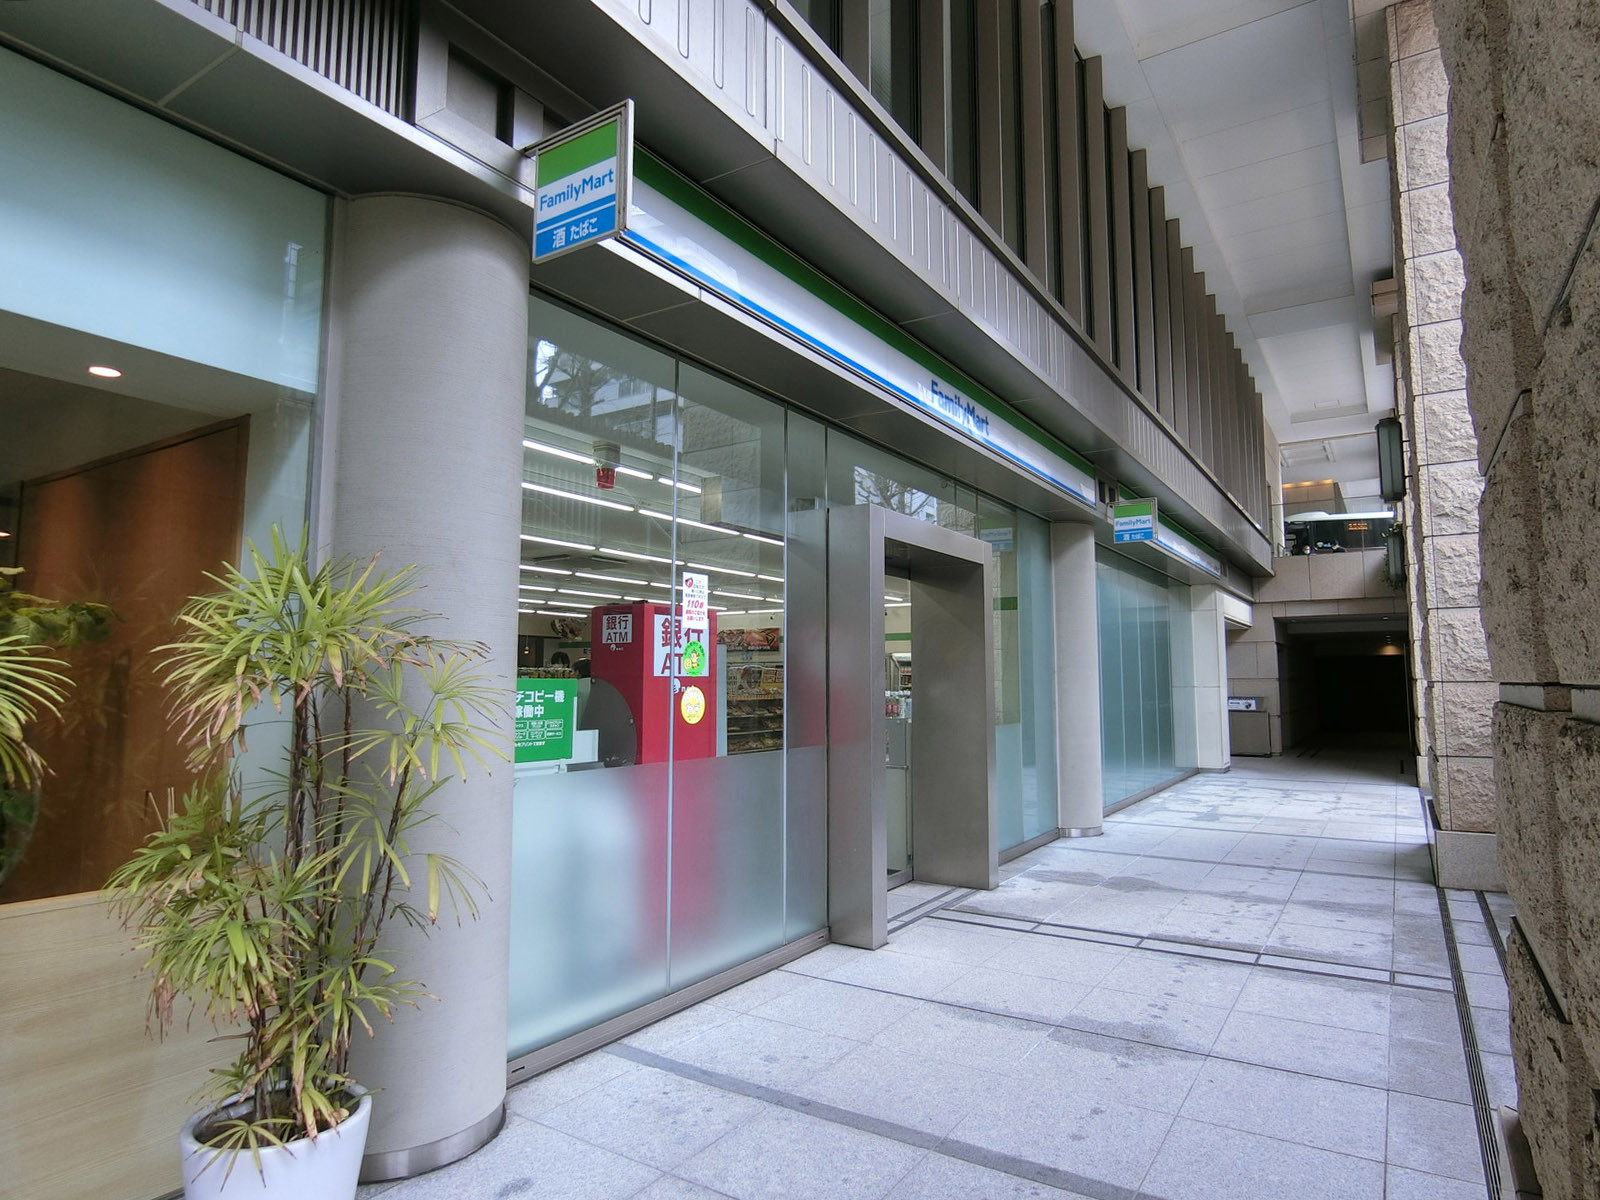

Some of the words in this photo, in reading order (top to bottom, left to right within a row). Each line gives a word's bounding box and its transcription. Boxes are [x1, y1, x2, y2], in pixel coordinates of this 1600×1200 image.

[540, 168, 614, 212] FamilyMart
[552, 226, 566, 249] 酒
[569, 217, 598, 241] たばこ
[930, 379, 990, 437] FamilyMart
[1115, 518, 1151, 527] FamilyMart
[606, 615, 629, 630] 銀行
[606, 631, 628, 643] ATM
[661, 653, 684, 675] AT
